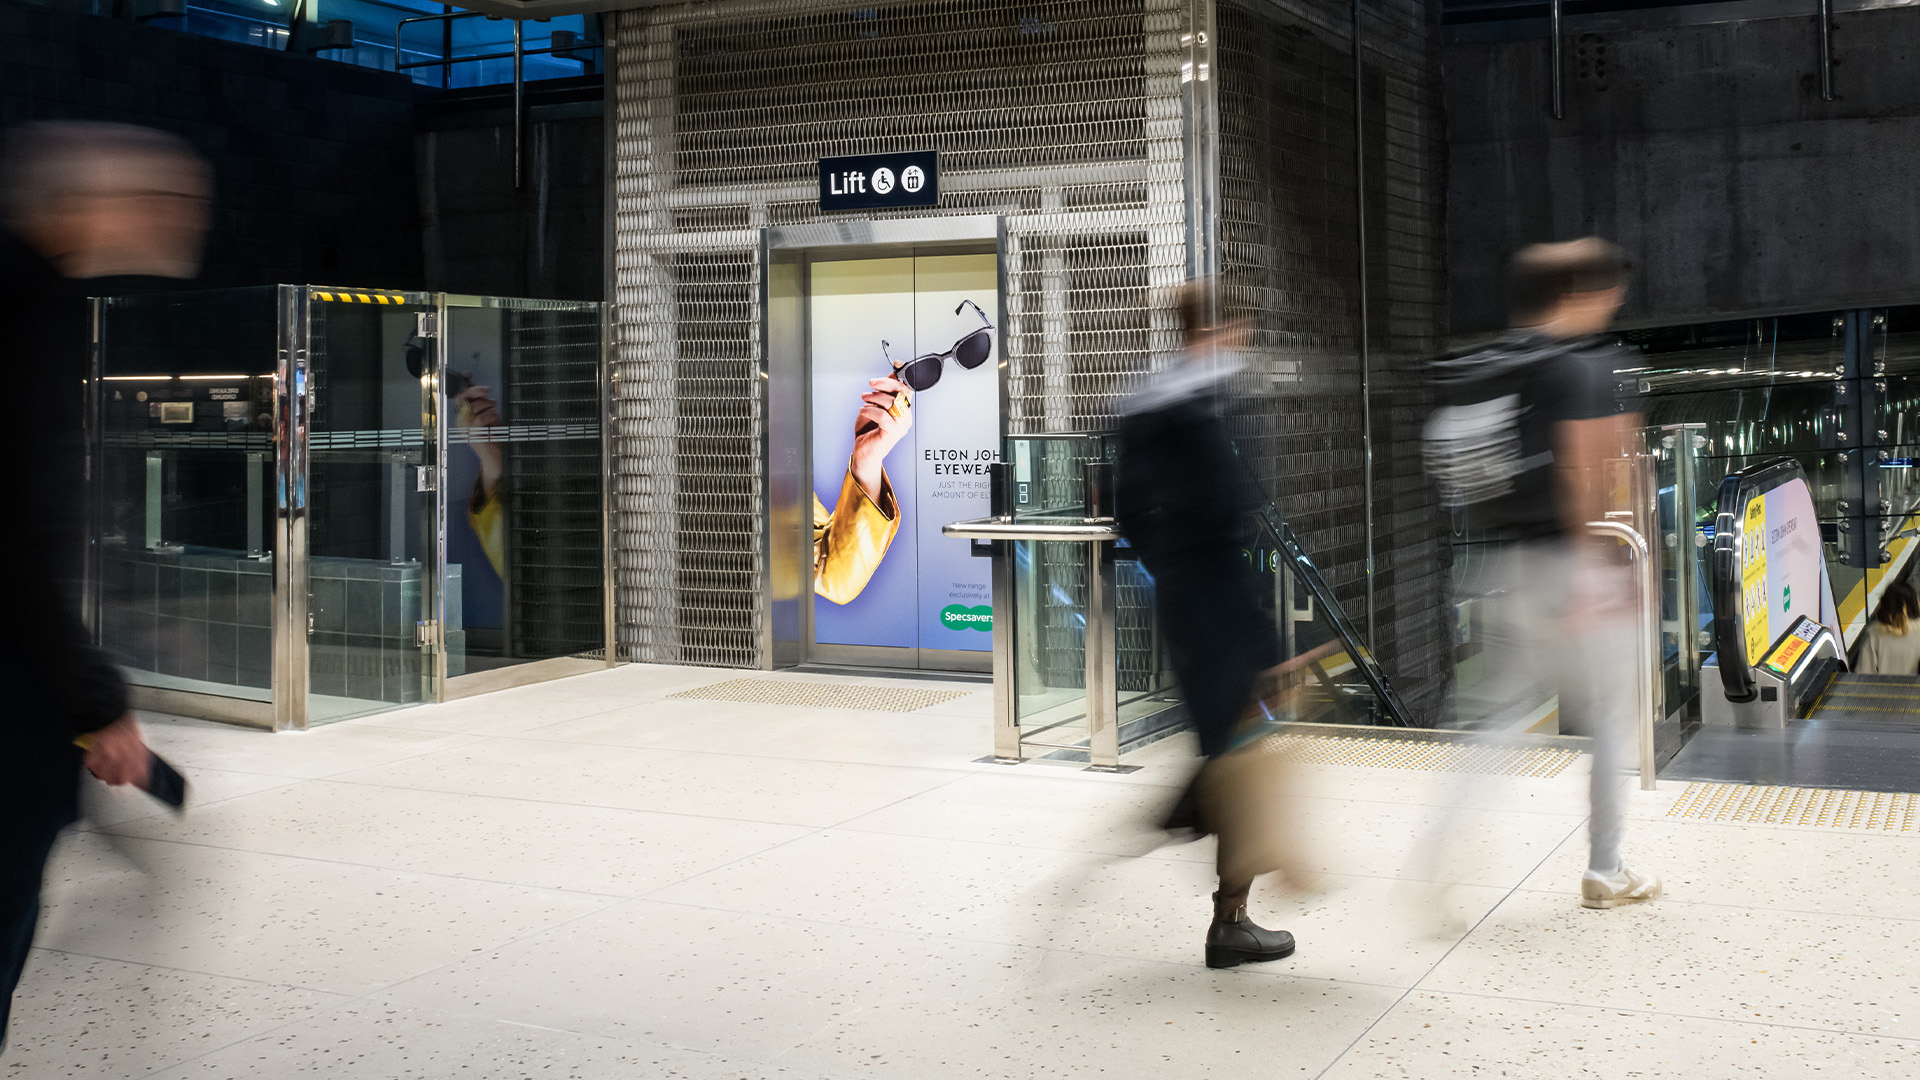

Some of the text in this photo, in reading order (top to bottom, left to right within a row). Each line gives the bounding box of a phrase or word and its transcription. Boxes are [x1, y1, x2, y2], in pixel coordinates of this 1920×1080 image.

[830, 170, 866, 195] Lift
[925, 449, 1000, 461] ELTON JOH
[935, 464, 991, 475] EYEWEA
[938, 481, 991, 489] JUST THE RIGH
[931, 491, 965, 499] AMOUNT
[967, 491, 979, 499] OF
[968, 583, 987, 591] range
[949, 592, 983, 600] exclusively
